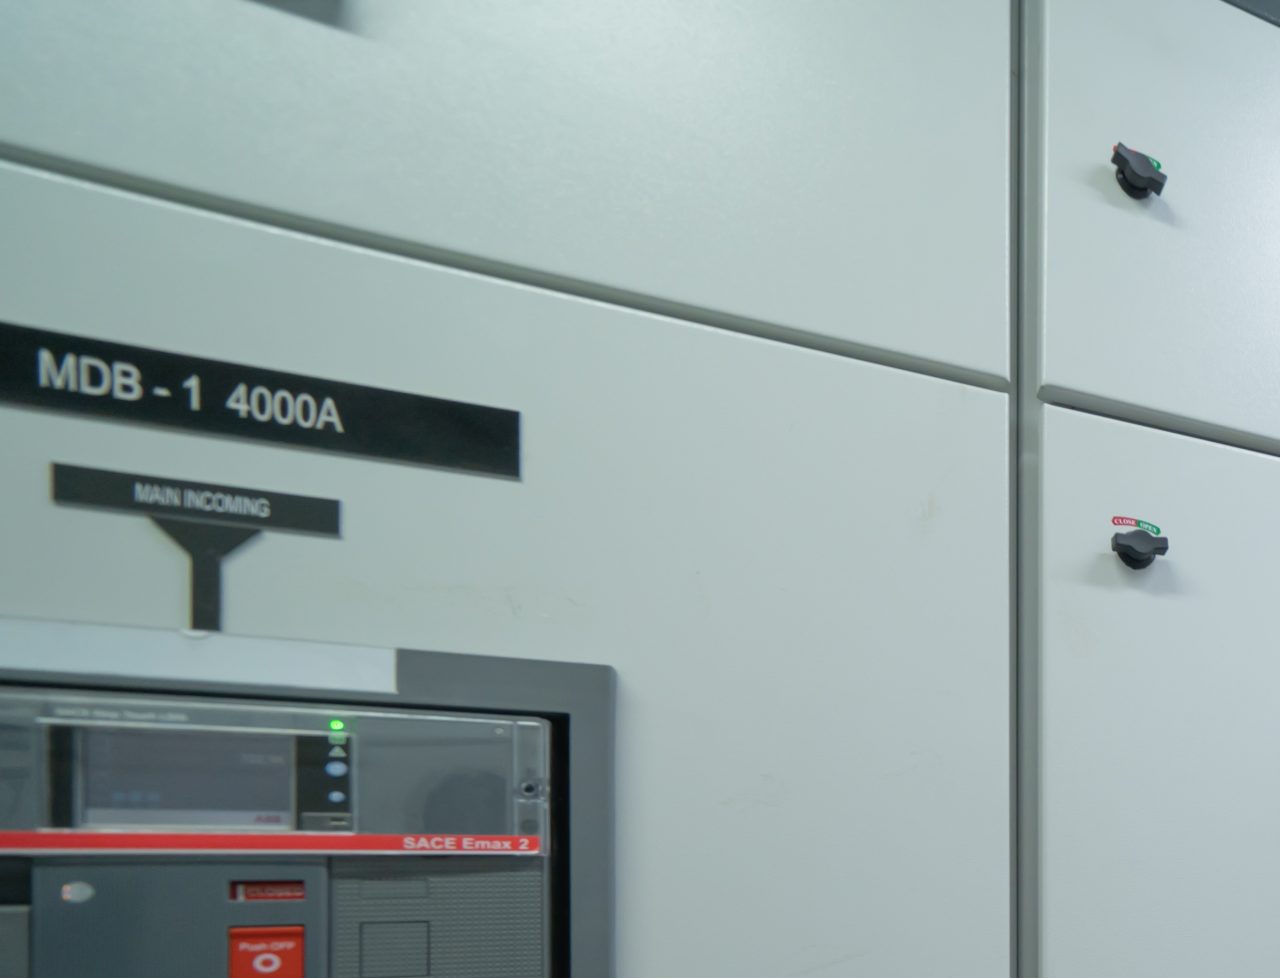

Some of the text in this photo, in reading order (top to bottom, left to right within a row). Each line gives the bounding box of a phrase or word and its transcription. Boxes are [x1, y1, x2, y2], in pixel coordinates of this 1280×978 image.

[37, 348, 144, 402] MDB
[226, 382, 345, 433] 4000A
[134, 482, 271, 518] MAIN INCOMING
[1113, 517, 1136, 526] CLOSE
[403, 837, 529, 850] SACE Emax 2
